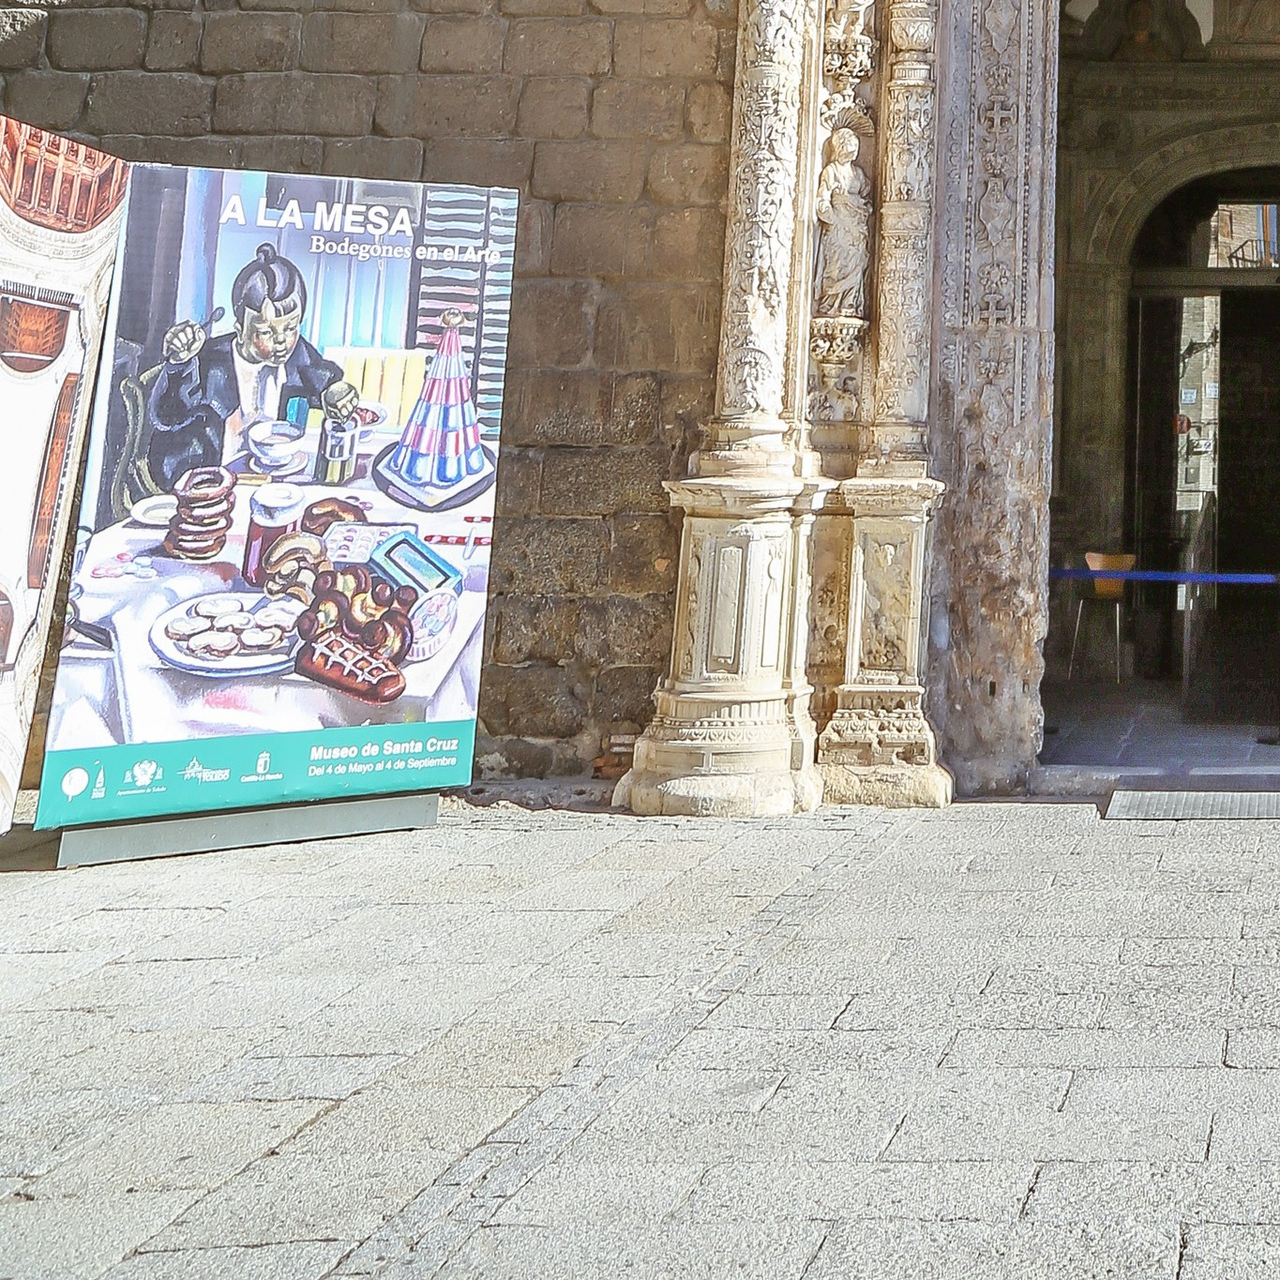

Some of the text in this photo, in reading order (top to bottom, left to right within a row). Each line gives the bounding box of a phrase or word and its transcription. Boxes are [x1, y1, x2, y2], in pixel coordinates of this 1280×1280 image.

[219, 194, 415, 237] A LA MESA
[309, 235, 501, 264] Bodegones en el Arte
[310, 737, 459, 760] Museo de Santa Cruz
[308, 756, 457, 777] Del 4 de Mayo al 4 de Septiembre
